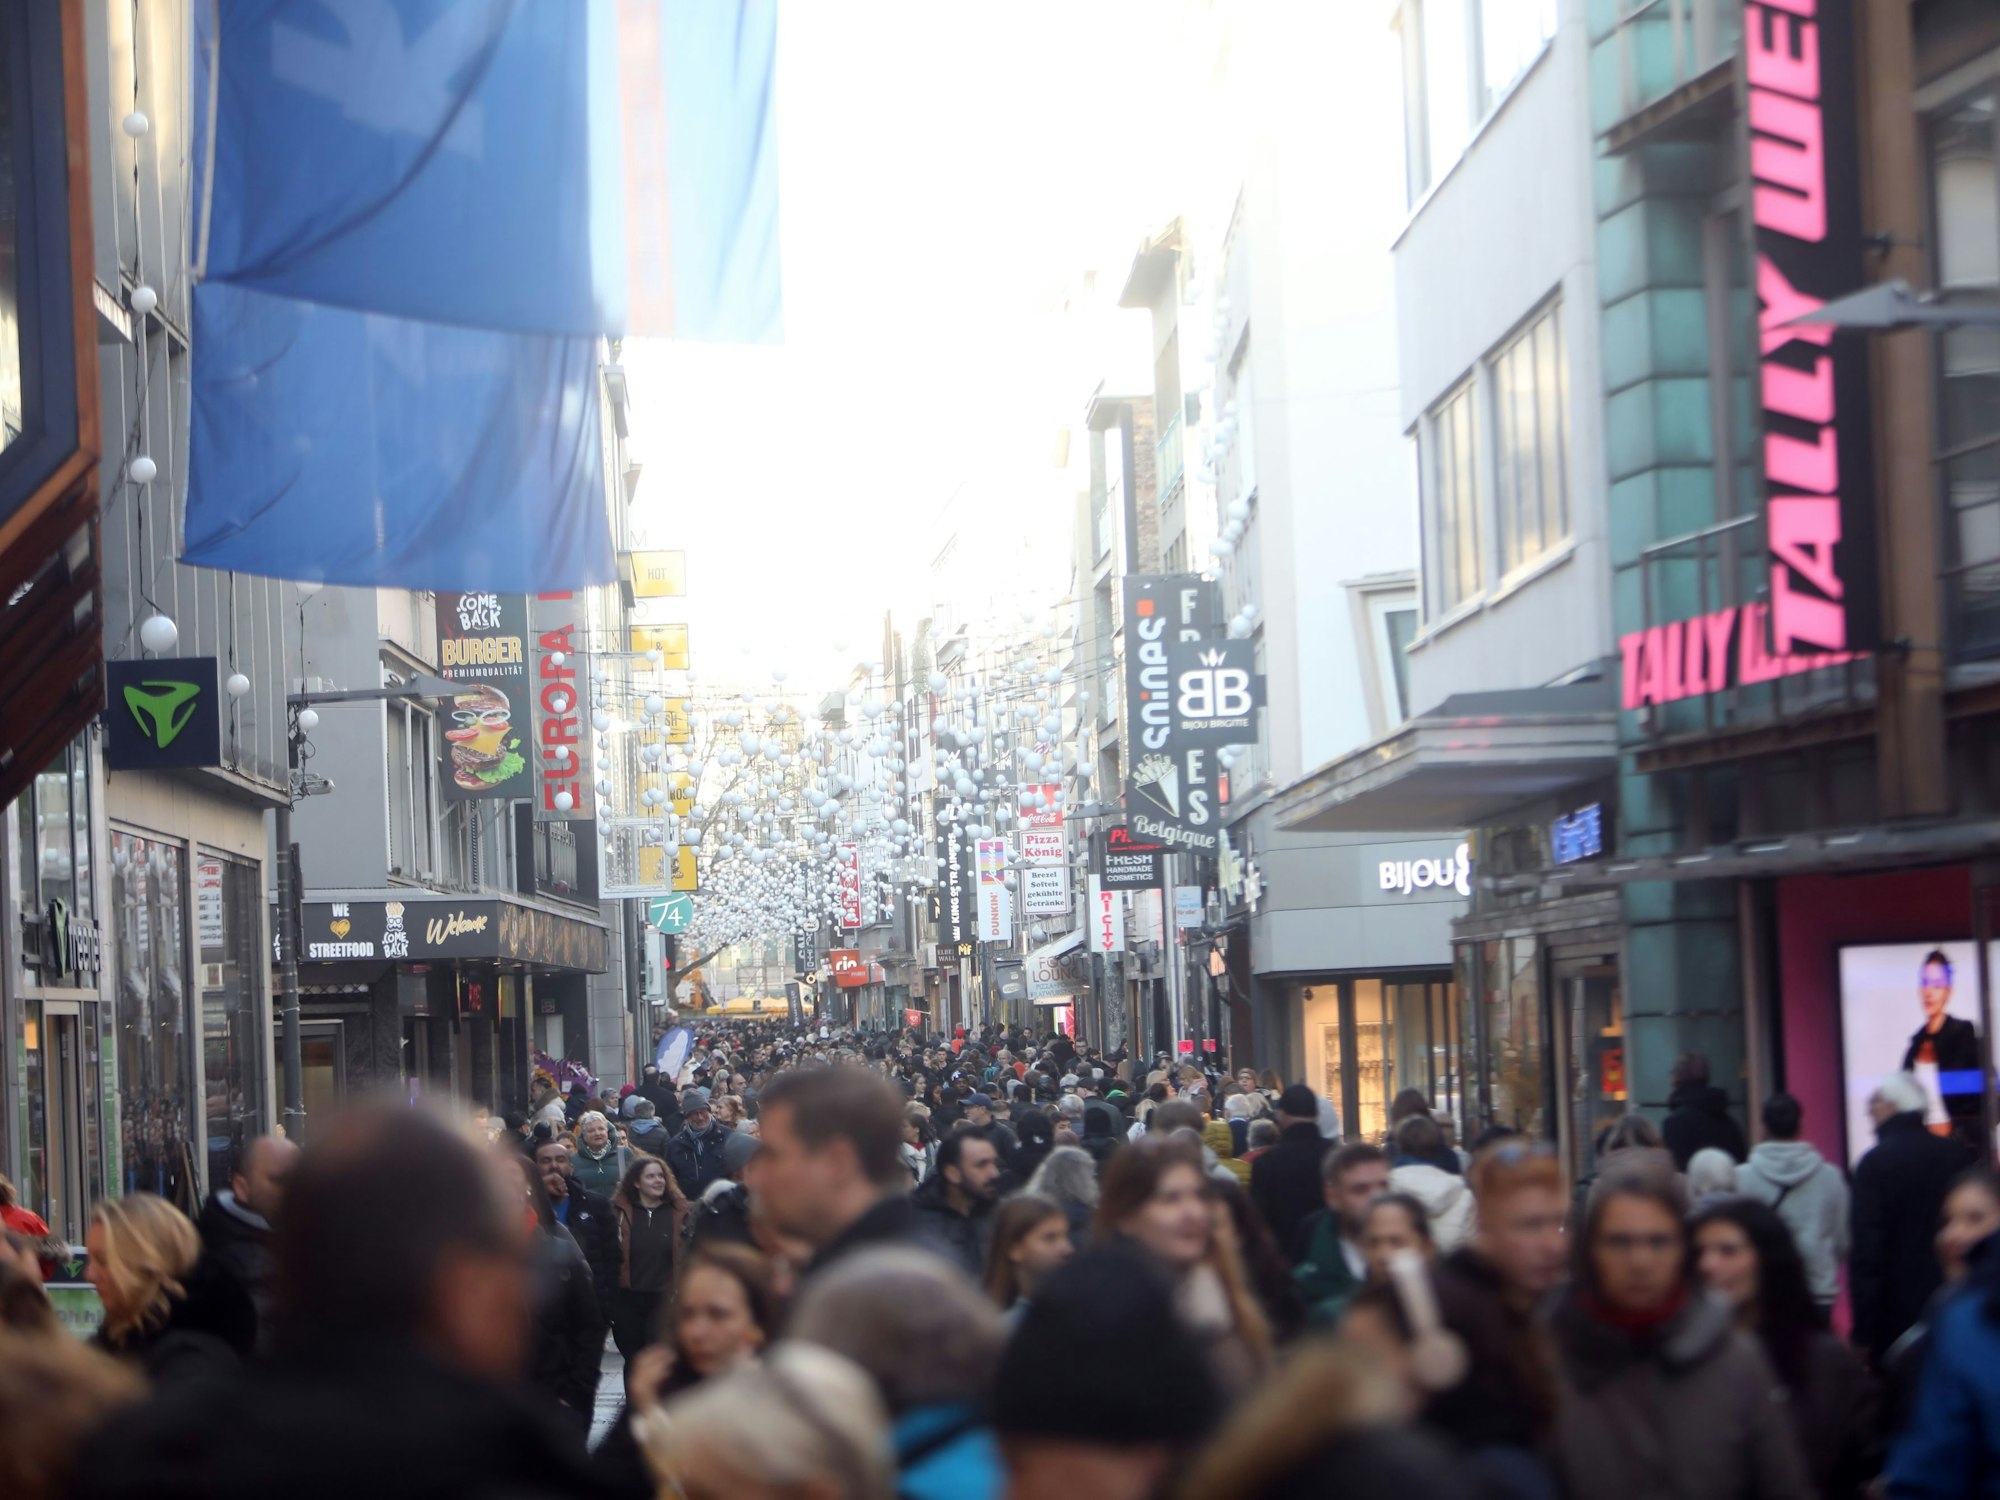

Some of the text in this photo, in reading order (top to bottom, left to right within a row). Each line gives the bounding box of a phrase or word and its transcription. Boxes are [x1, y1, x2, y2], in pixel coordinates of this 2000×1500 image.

[1746, 0, 1828, 243] WE
[1757, 253, 1846, 657] TALLY
[647, 567, 667, 581] HOT
[459, 594, 499, 614] COME
[459, 609, 501, 631] BACK
[441, 636, 523, 666] BURGER
[1619, 606, 1738, 710] TALLY
[442, 665, 523, 679] PREMIUMQUALITÄT
[538, 623, 581, 811] EUROPA
[1180, 718, 1249, 731] BIJOU BRIGITTE
[1026, 835, 1060, 845] Pizza
[1133, 815, 1216, 849] Belgique
[1024, 847, 1063, 859] König
[1105, 854, 1153, 866] FRESH
[1031, 871, 1057, 879] Brezel
[1106, 865, 1153, 874] HANDMADE
[1106, 873, 1154, 882] COSMETICS
[1378, 858, 1456, 895] BIJOU
[1027, 890, 1063, 899] gekühlte
[331, 903, 350, 917] WE
[951, 898, 960, 924] KING
[426, 910, 488, 945] Welcome
[383, 932, 407, 945] COME
[309, 942, 374, 958] STREETFOOD
[383, 942, 408, 958] BACK
